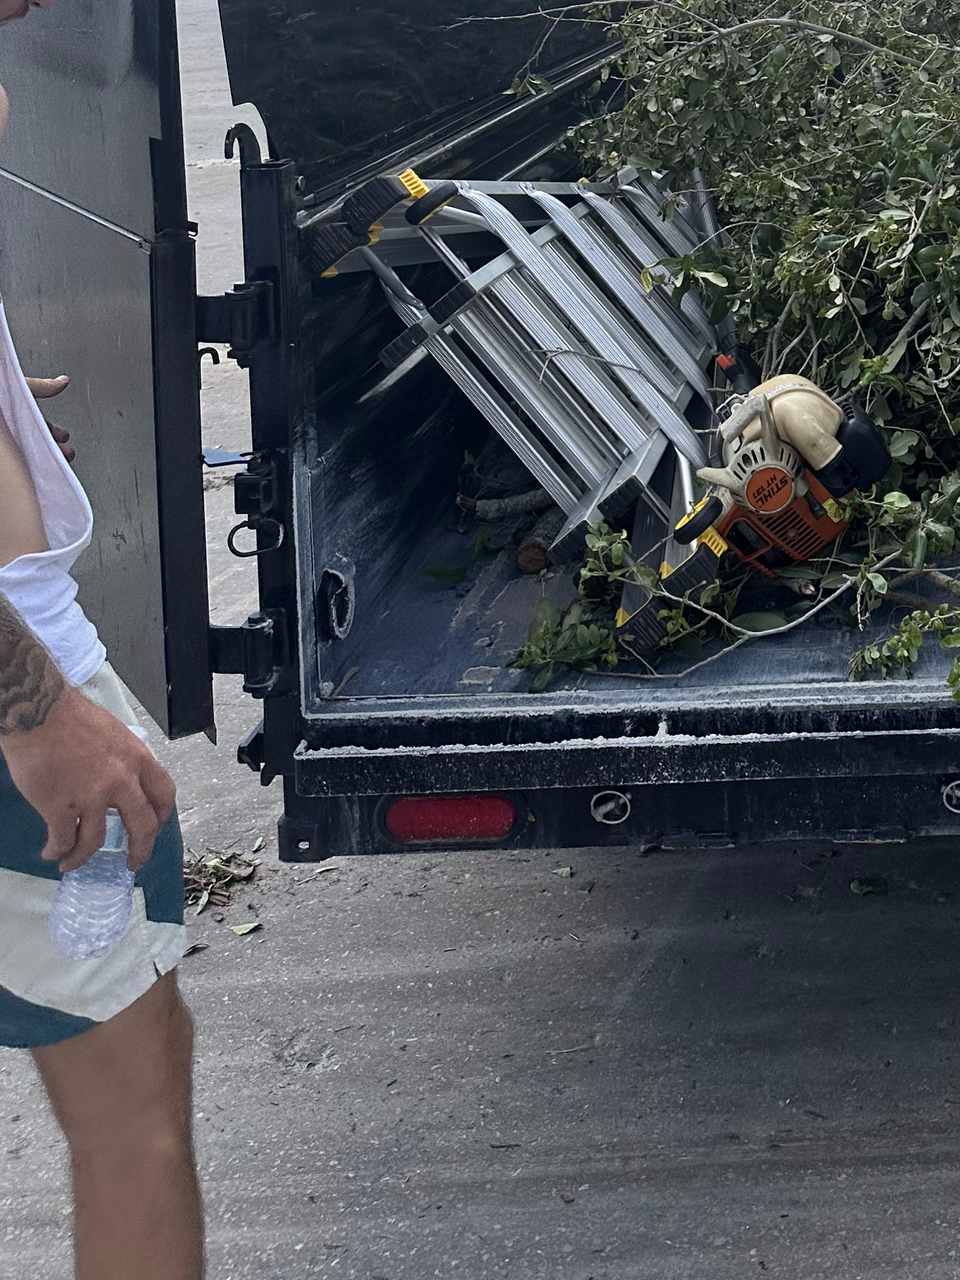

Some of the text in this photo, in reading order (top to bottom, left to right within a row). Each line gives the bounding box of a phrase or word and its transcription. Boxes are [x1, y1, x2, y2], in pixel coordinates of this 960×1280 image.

[752, 474, 777, 499] HT 131
[755, 475, 789, 505] STIHL
